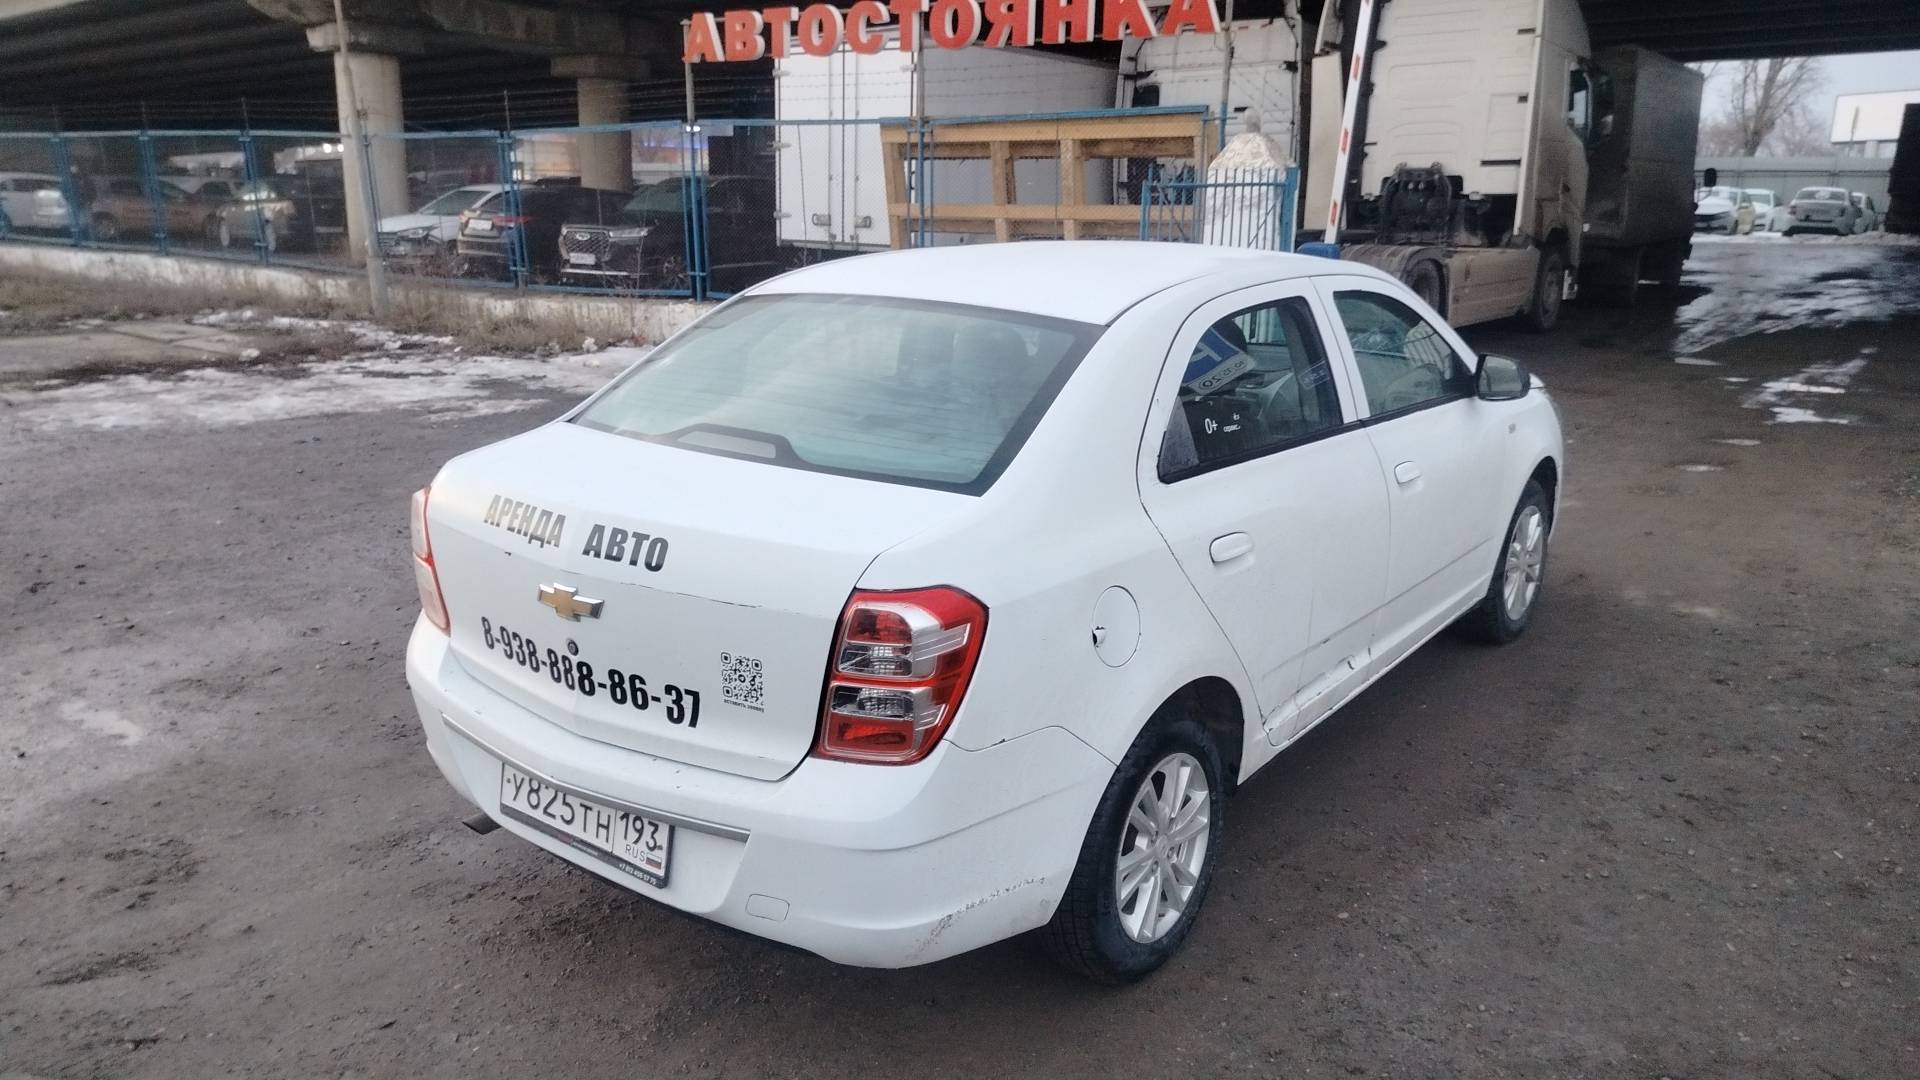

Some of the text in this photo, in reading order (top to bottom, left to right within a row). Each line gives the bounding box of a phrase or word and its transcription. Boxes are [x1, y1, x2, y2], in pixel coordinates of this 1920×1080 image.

[683, 0, 1220, 63] АВТОСТОЯНКА
[483, 494, 670, 573] АРЕНДА АВТО
[481, 616, 701, 729] 8-938-888-86-37
[620, 812, 660, 852] 193
[625, 843, 646, 863] RUS
